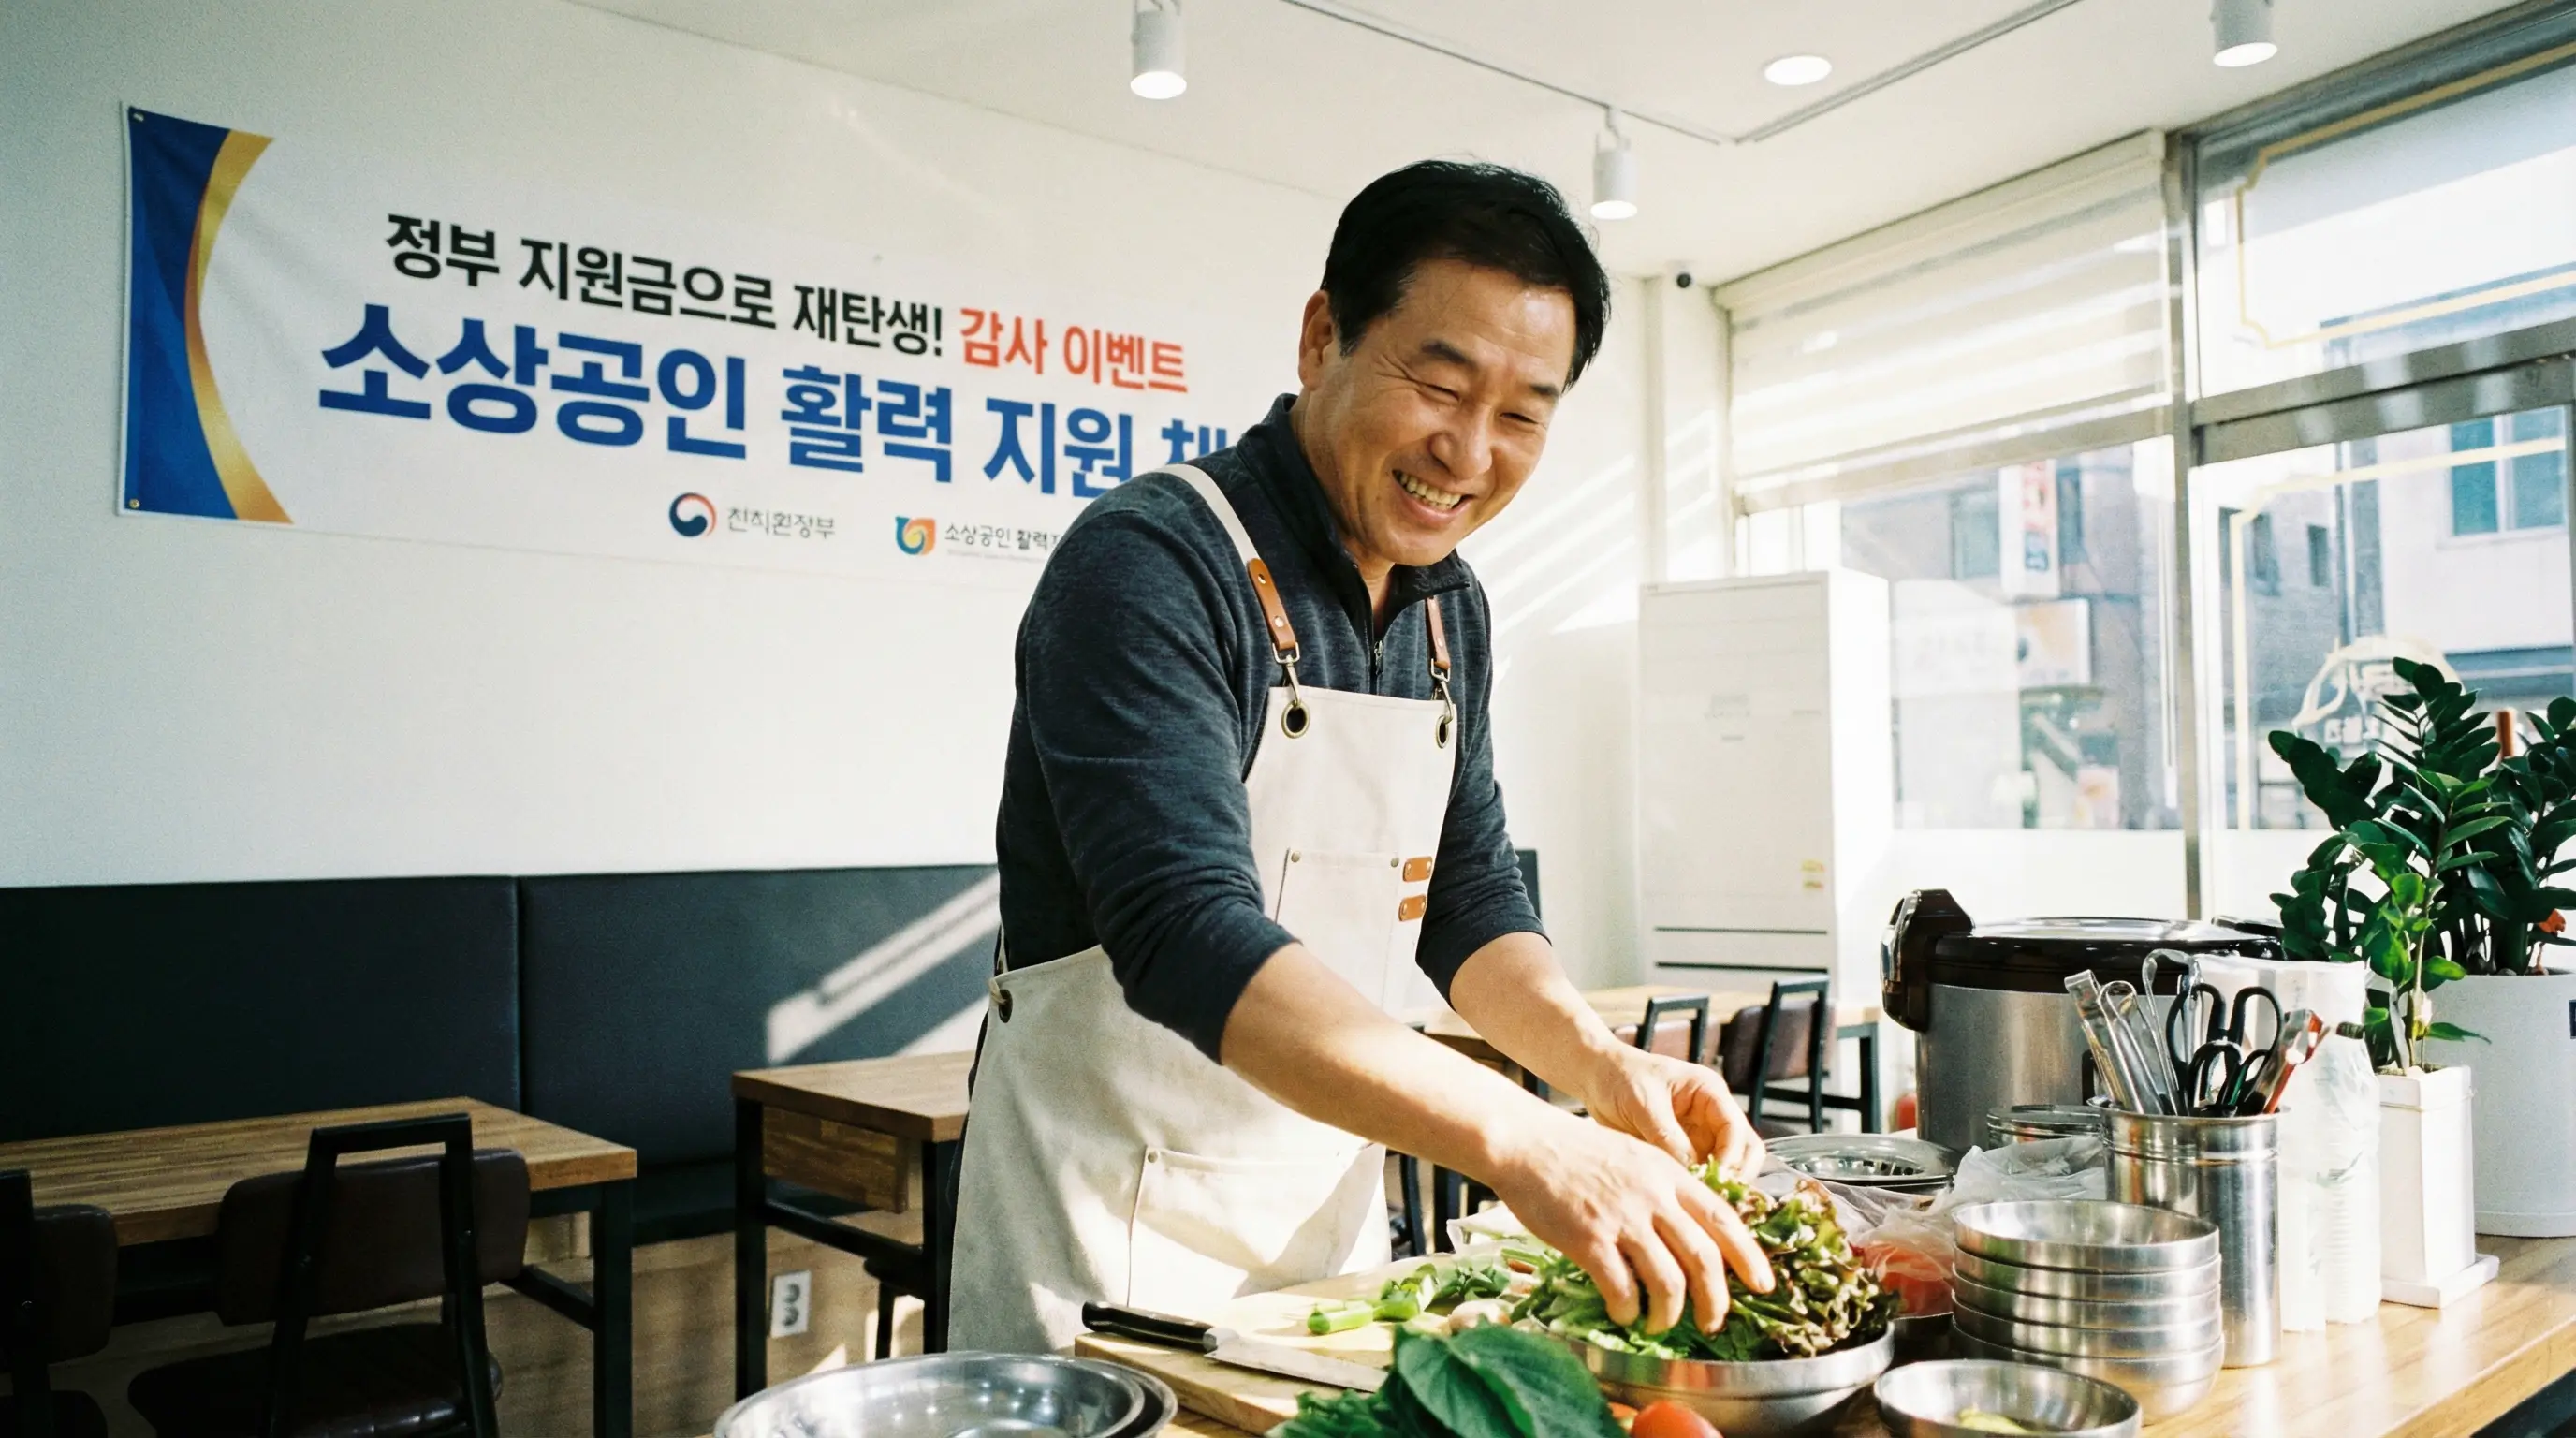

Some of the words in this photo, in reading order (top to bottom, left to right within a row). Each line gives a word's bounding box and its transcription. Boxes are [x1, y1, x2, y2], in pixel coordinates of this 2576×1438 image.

[386, 213, 500, 287] 정부
[519, 238, 776, 330] 지원금으로
[793, 285, 943, 357] 재탄생!
[959, 307, 1049, 375] 감사
[1062, 324, 1189, 394] 이벤트
[318, 302, 747, 461] 소상공인
[781, 364, 953, 484] 활력
[982, 396, 1134, 500] 지원
[944, 521, 1011, 550] 소상공인
